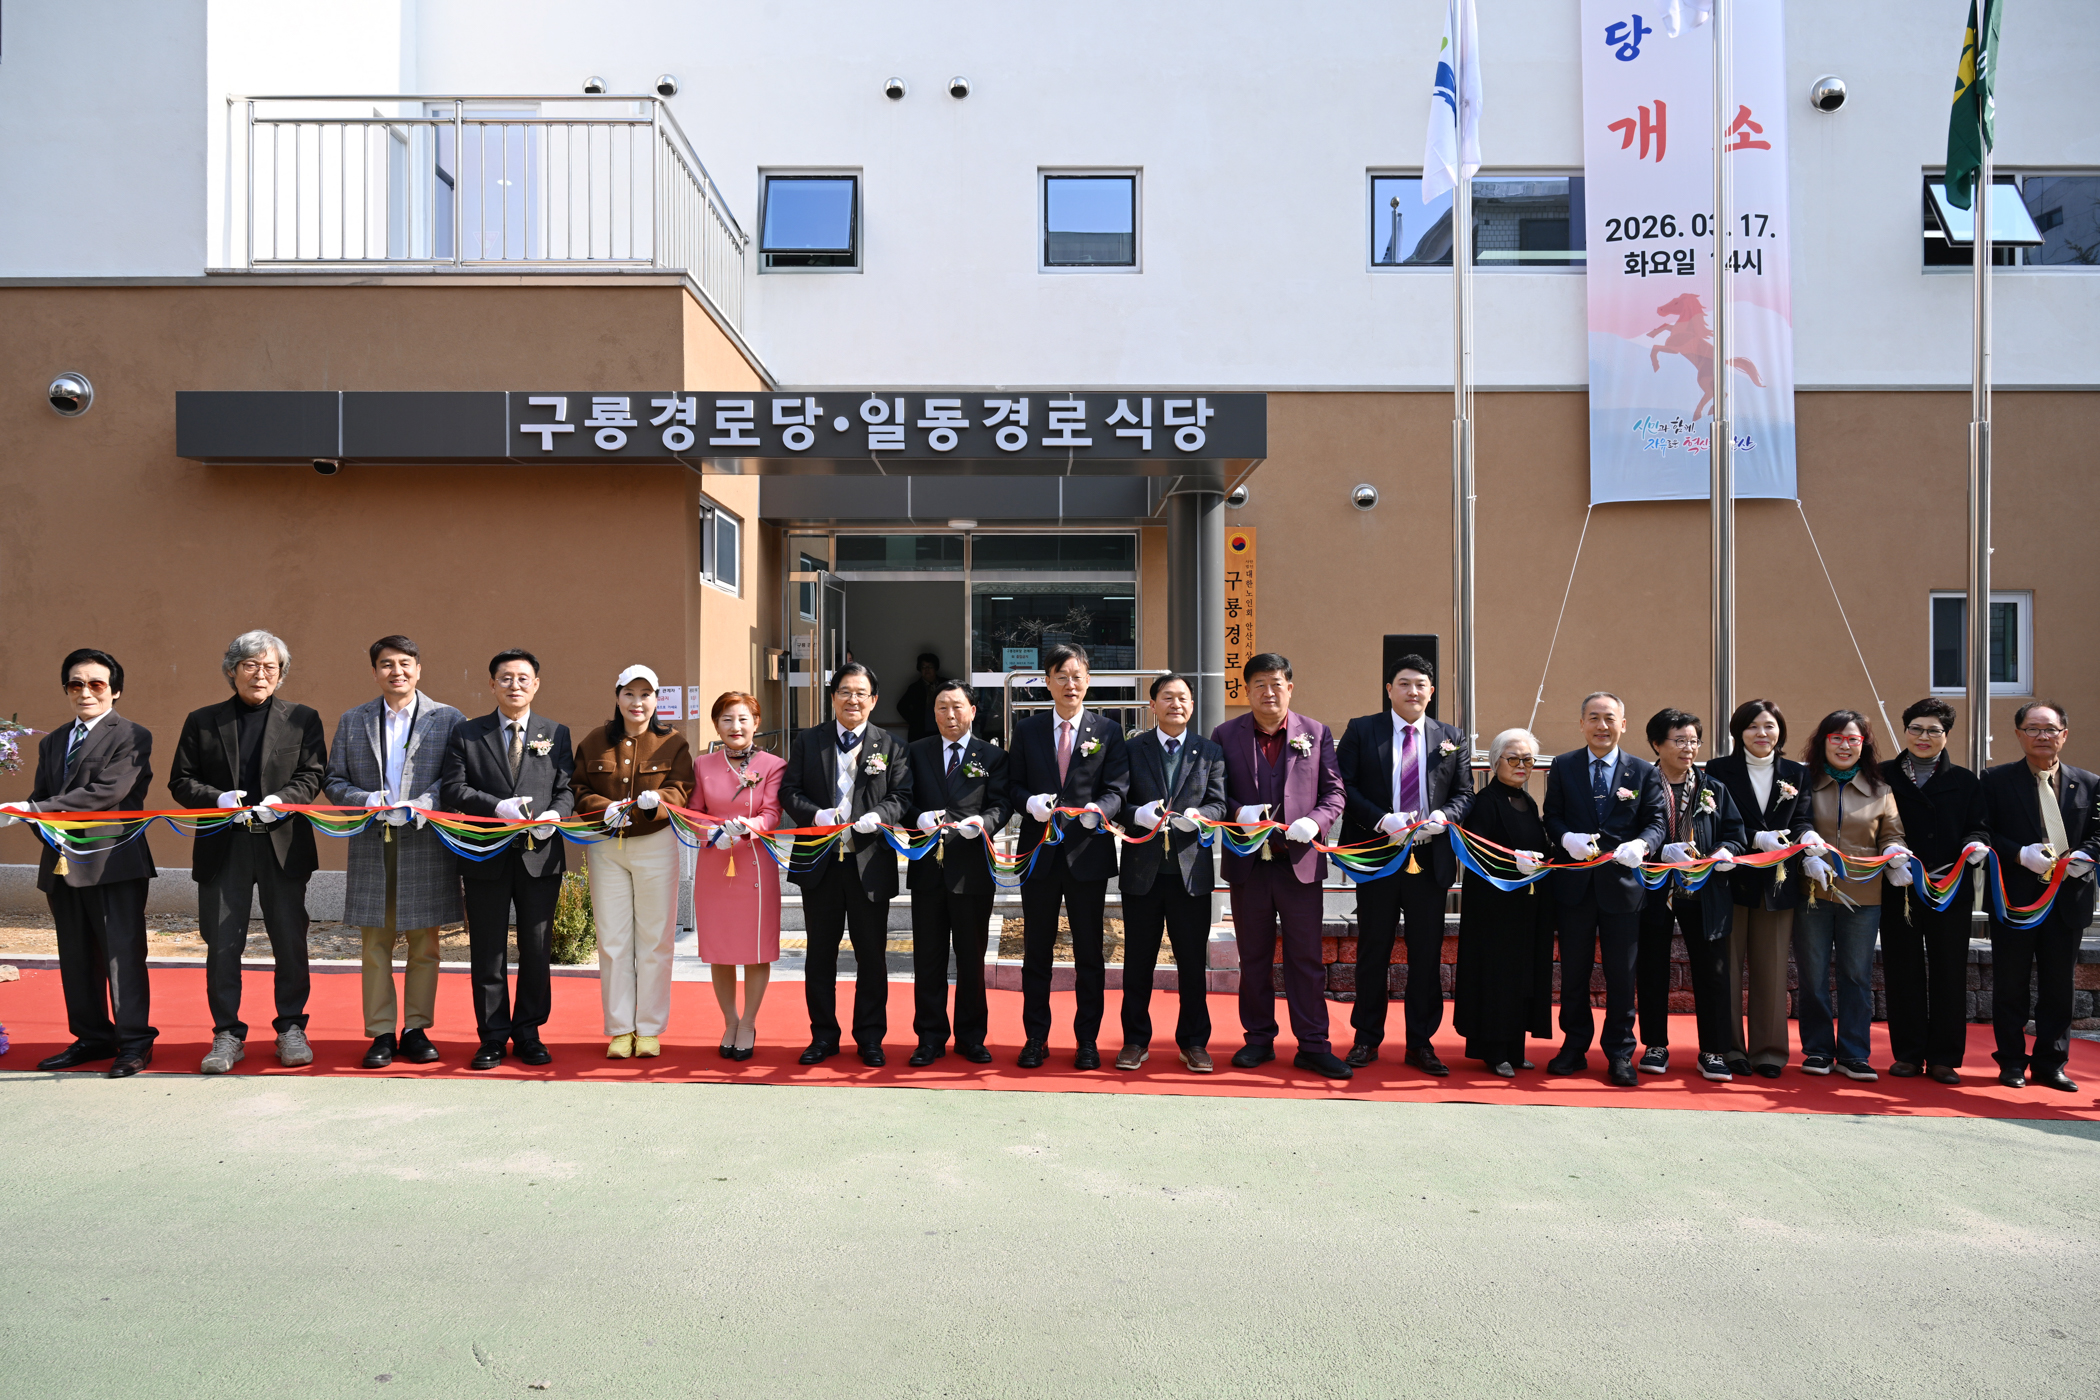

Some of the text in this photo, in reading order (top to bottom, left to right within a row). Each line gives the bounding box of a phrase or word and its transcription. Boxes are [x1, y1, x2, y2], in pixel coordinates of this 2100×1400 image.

[1605, 14, 1652, 61] 당
[1605, 214, 1684, 242] 2026.
[1740, 213, 1776, 238] 17.
[1624, 249, 1762, 277] 화요일 4시
[1633, 416, 1669, 439] 시민과
[1644, 438, 1679, 457] 자유로운
[1225, 571, 1243, 699] 구룡경로당
